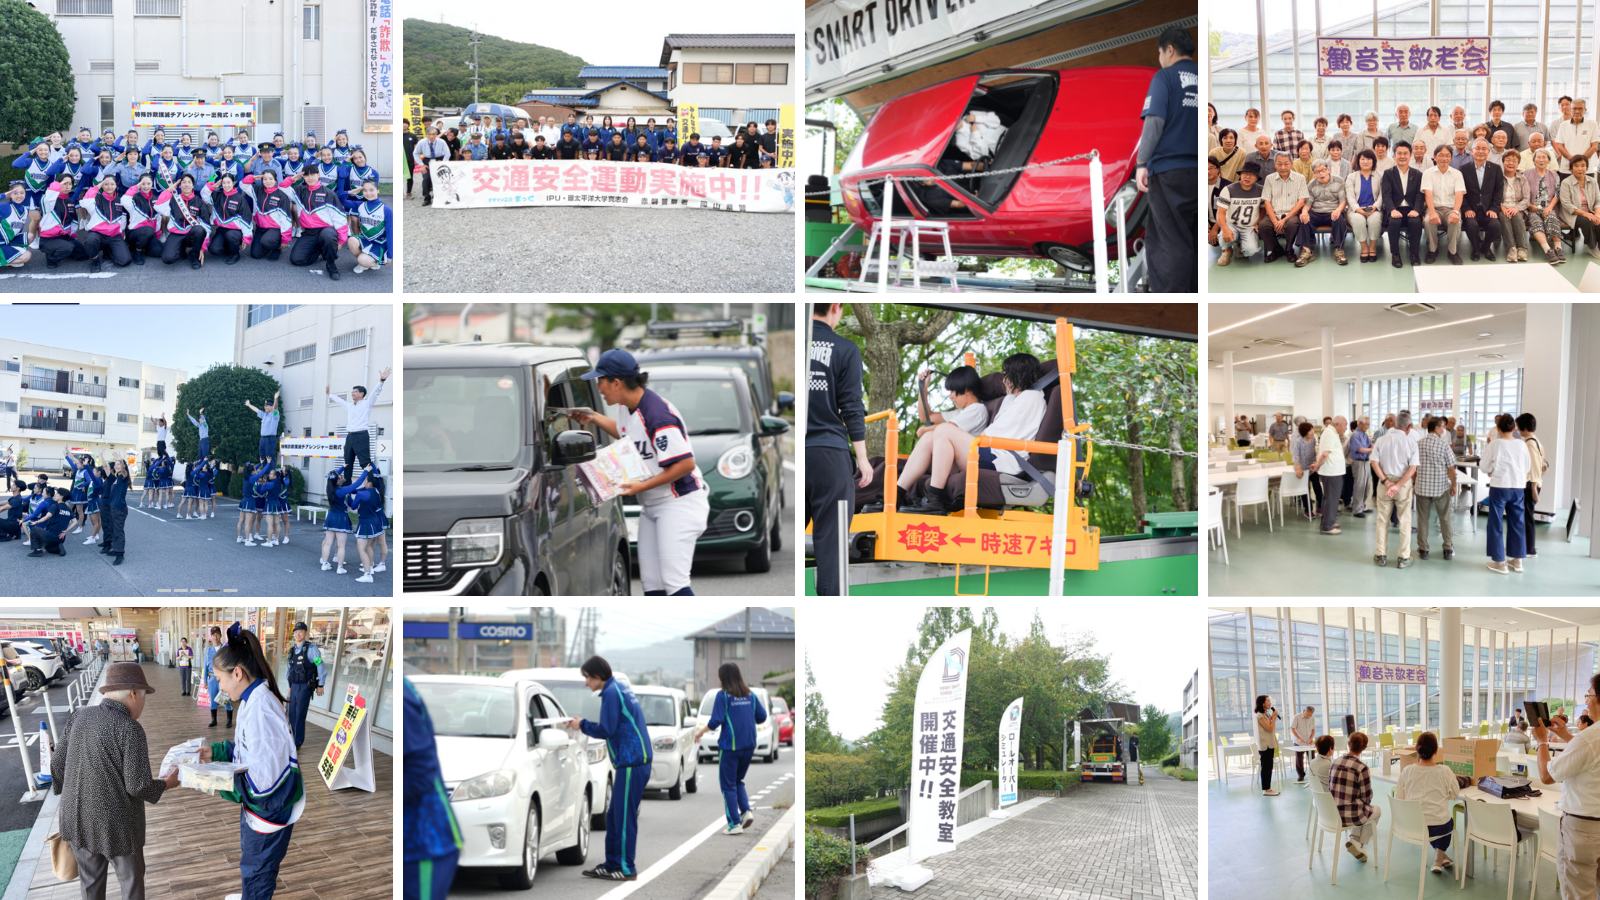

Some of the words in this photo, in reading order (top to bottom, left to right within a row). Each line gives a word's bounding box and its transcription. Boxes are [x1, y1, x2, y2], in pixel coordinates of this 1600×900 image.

[813, 1, 878, 65] SMART
[885, 0, 976, 36] DRIV
[1326, 45, 1487, 72] 観音寺敬老会
[472, 163, 762, 201] 交通安全運動実施中!!
[1231, 205, 1254, 225] 49
[905, 528, 940, 547] 衝突
[480, 626, 527, 638] COSMO
[1359, 665, 1426, 682] 観音寺敬老会
[919, 711, 938, 799] 開催中!!
[937, 709, 957, 843] 交通安全教室
